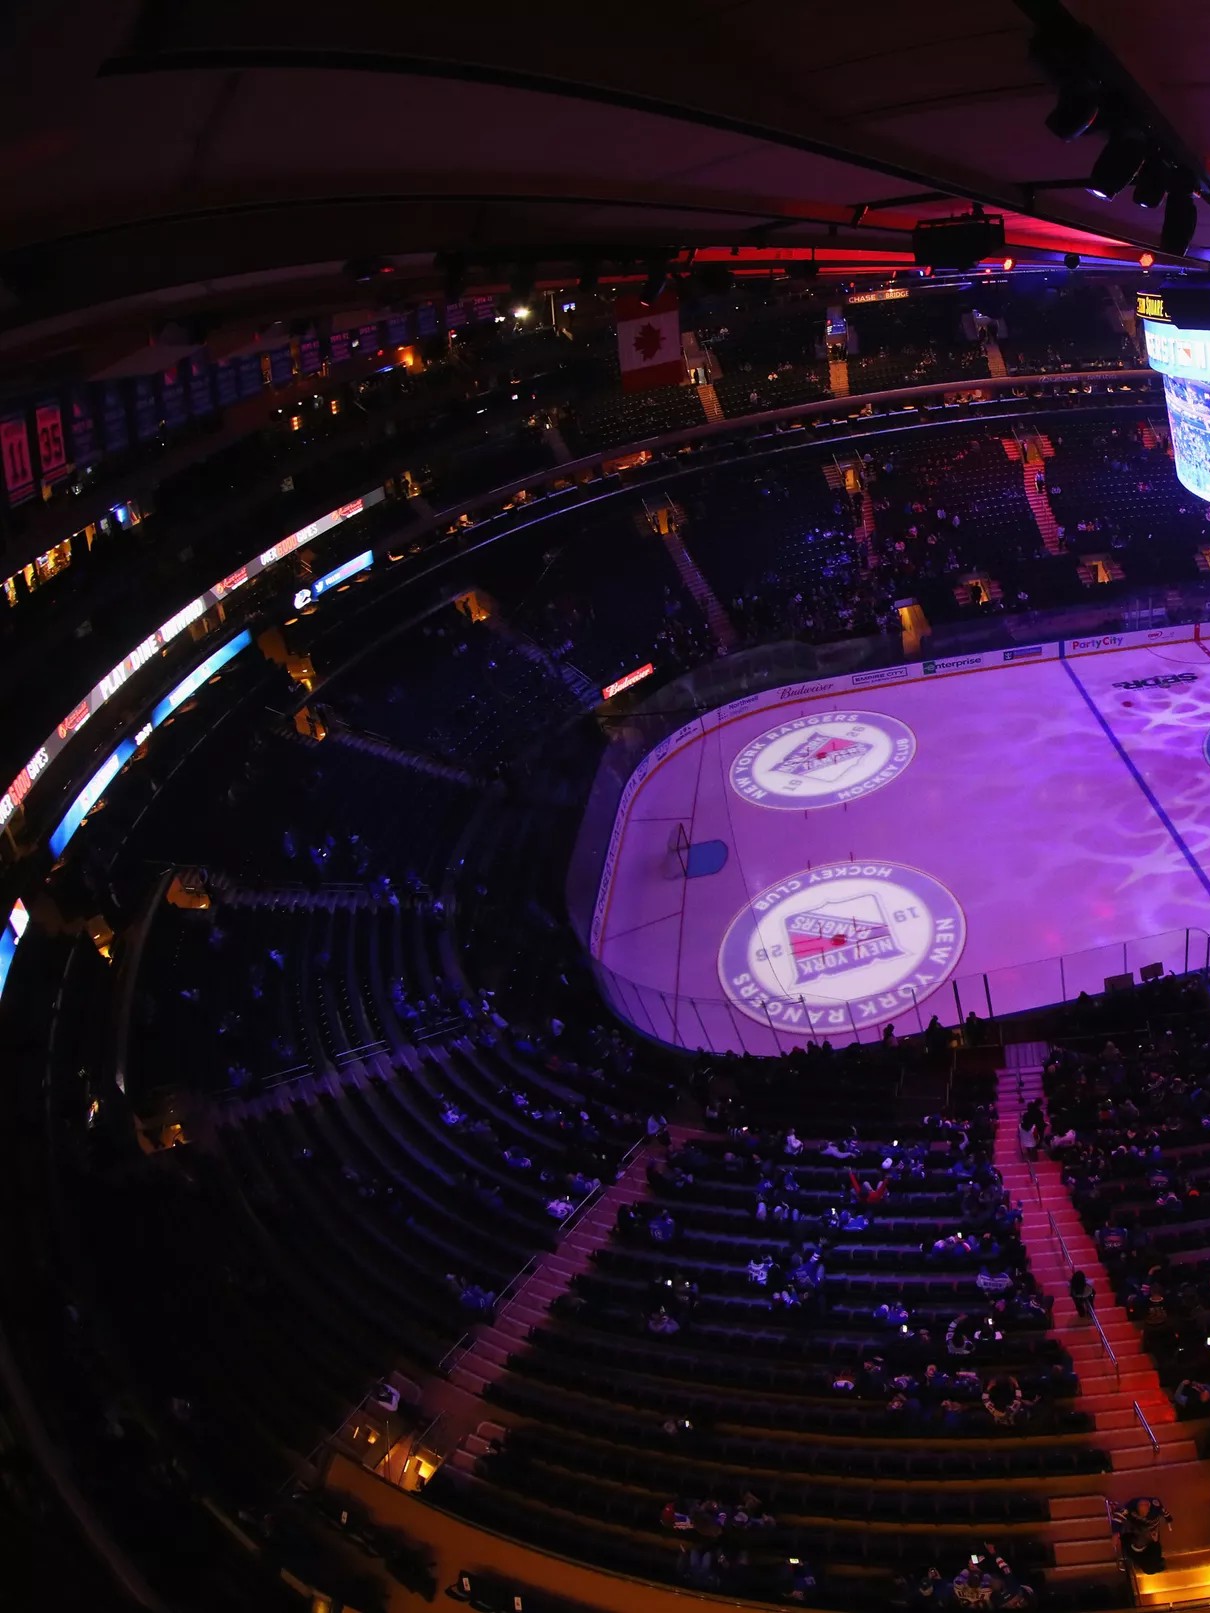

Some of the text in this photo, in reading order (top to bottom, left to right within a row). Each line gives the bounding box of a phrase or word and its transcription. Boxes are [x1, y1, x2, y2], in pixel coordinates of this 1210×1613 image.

[848, 290, 909, 303] CHASE BRIDGE
[100, 661, 128, 701] PLAY
[129, 633, 160, 671] DINE
[926, 656, 982, 672] enterprise
[605, 667, 651, 698] Budweiser
[776, 681, 834, 700] Budweiser
[728, 695, 759, 711] Northwell
[736, 714, 860, 800] NEW YORK RANGERS
[838, 738, 911, 800] HOCKEY CLUB
[753, 866, 892, 911] HOCKEY CLUB
[791, 915, 872, 941] RANGERS
[894, 906, 920, 923] 19
[733, 917, 955, 1024] NEW YORK RANGERS
[800, 938, 893, 976] NEW YORK
